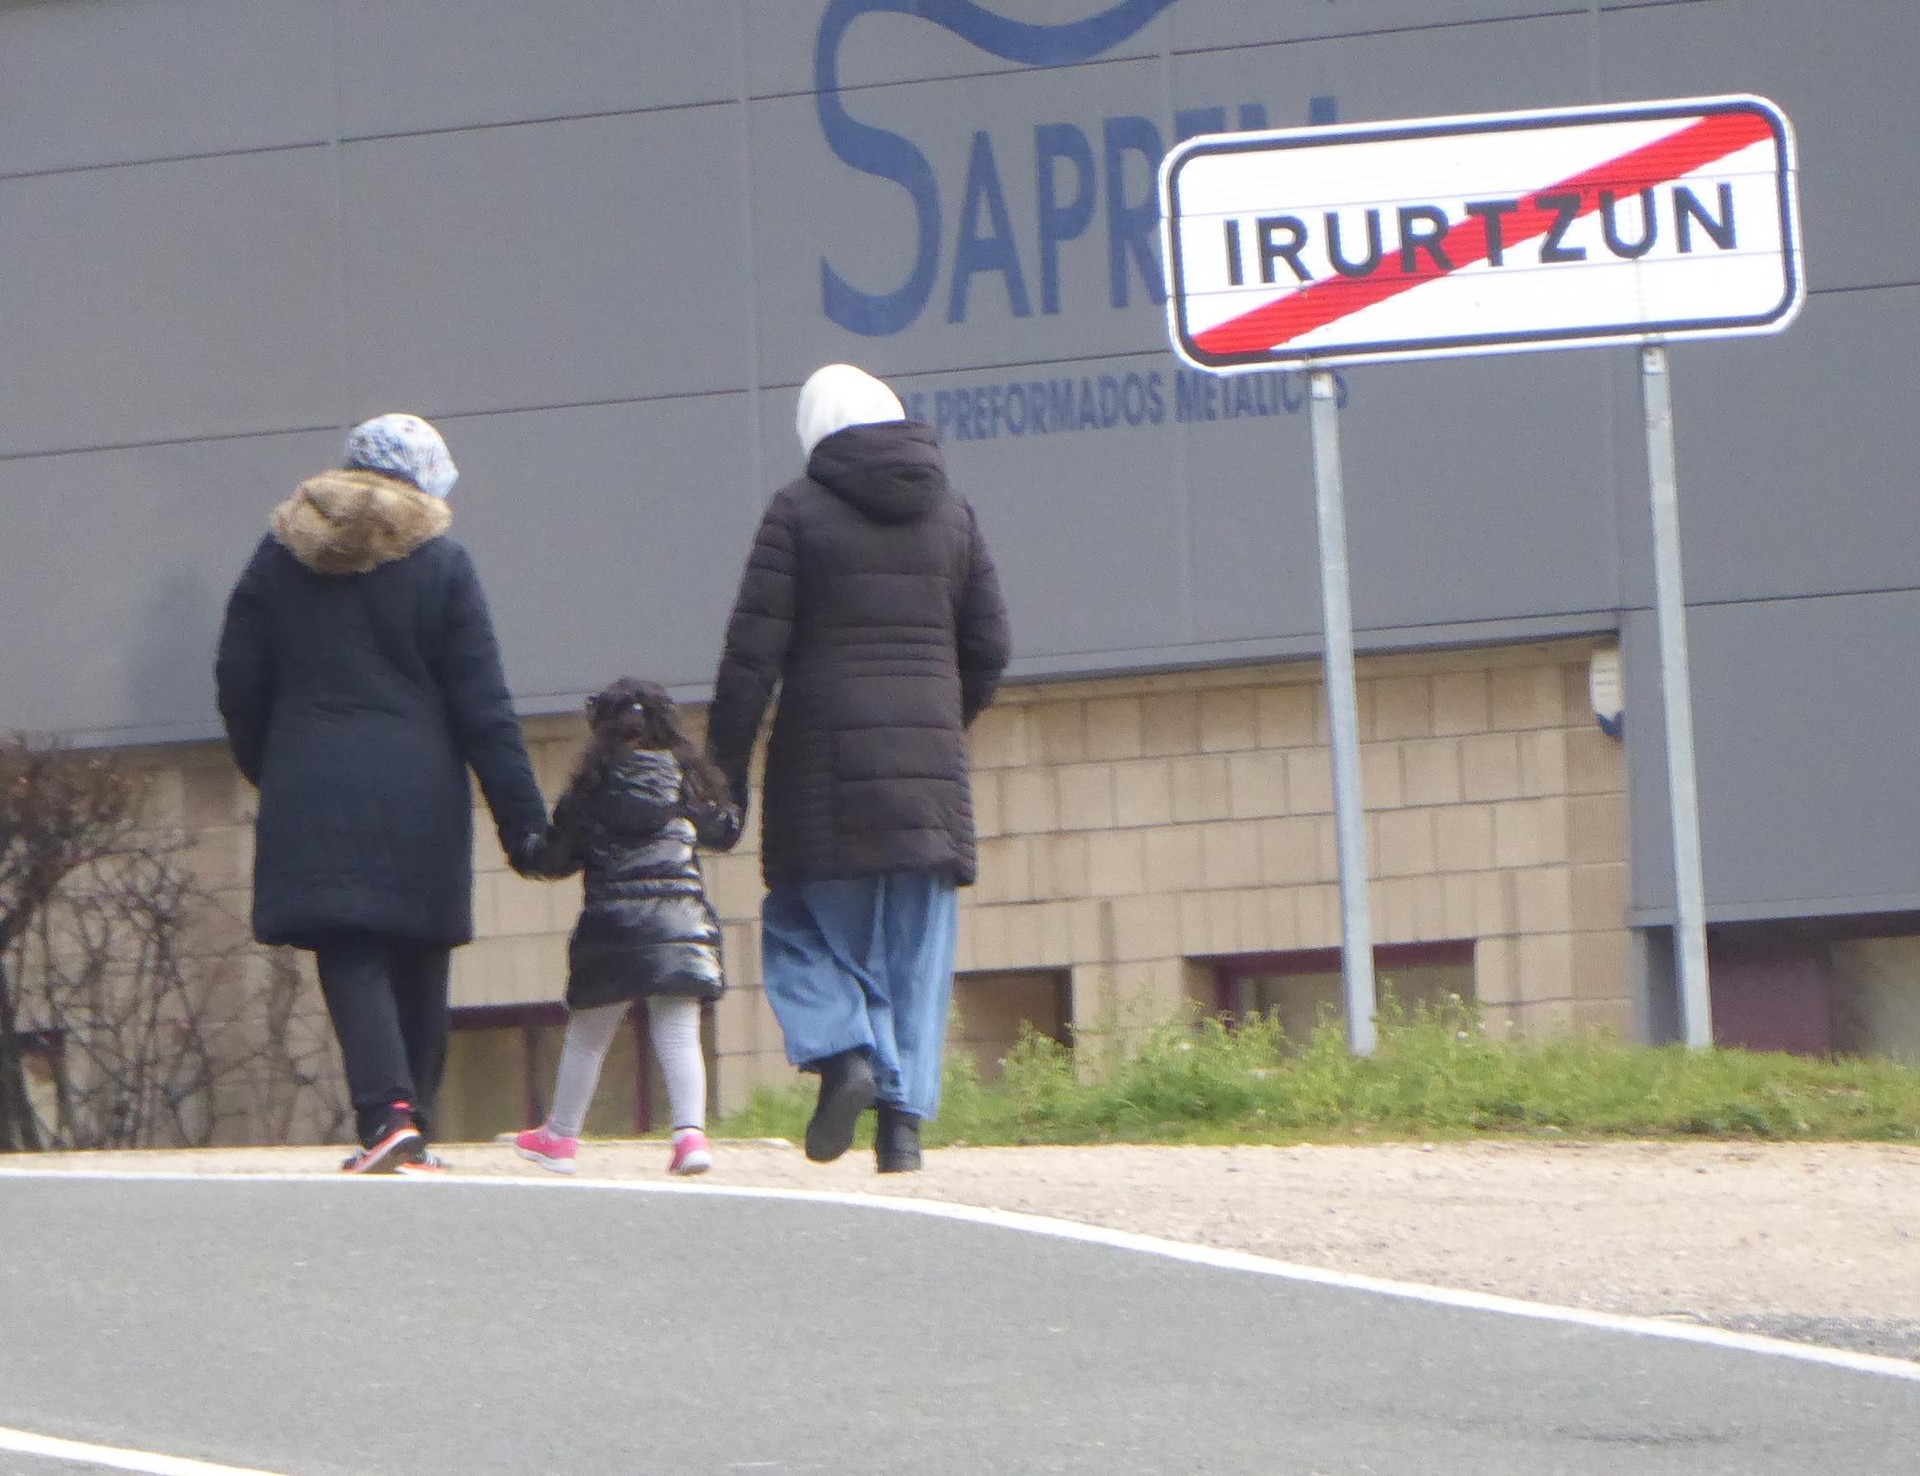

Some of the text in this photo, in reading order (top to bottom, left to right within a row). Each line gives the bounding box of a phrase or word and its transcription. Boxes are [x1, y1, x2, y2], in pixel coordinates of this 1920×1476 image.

[814, 0, 1338, 337] SAPR
[1223, 183, 1737, 287] IRURTZUN
[934, 370, 1163, 442] PREFORMADOS
[1175, 368, 1348, 423] METALICS
